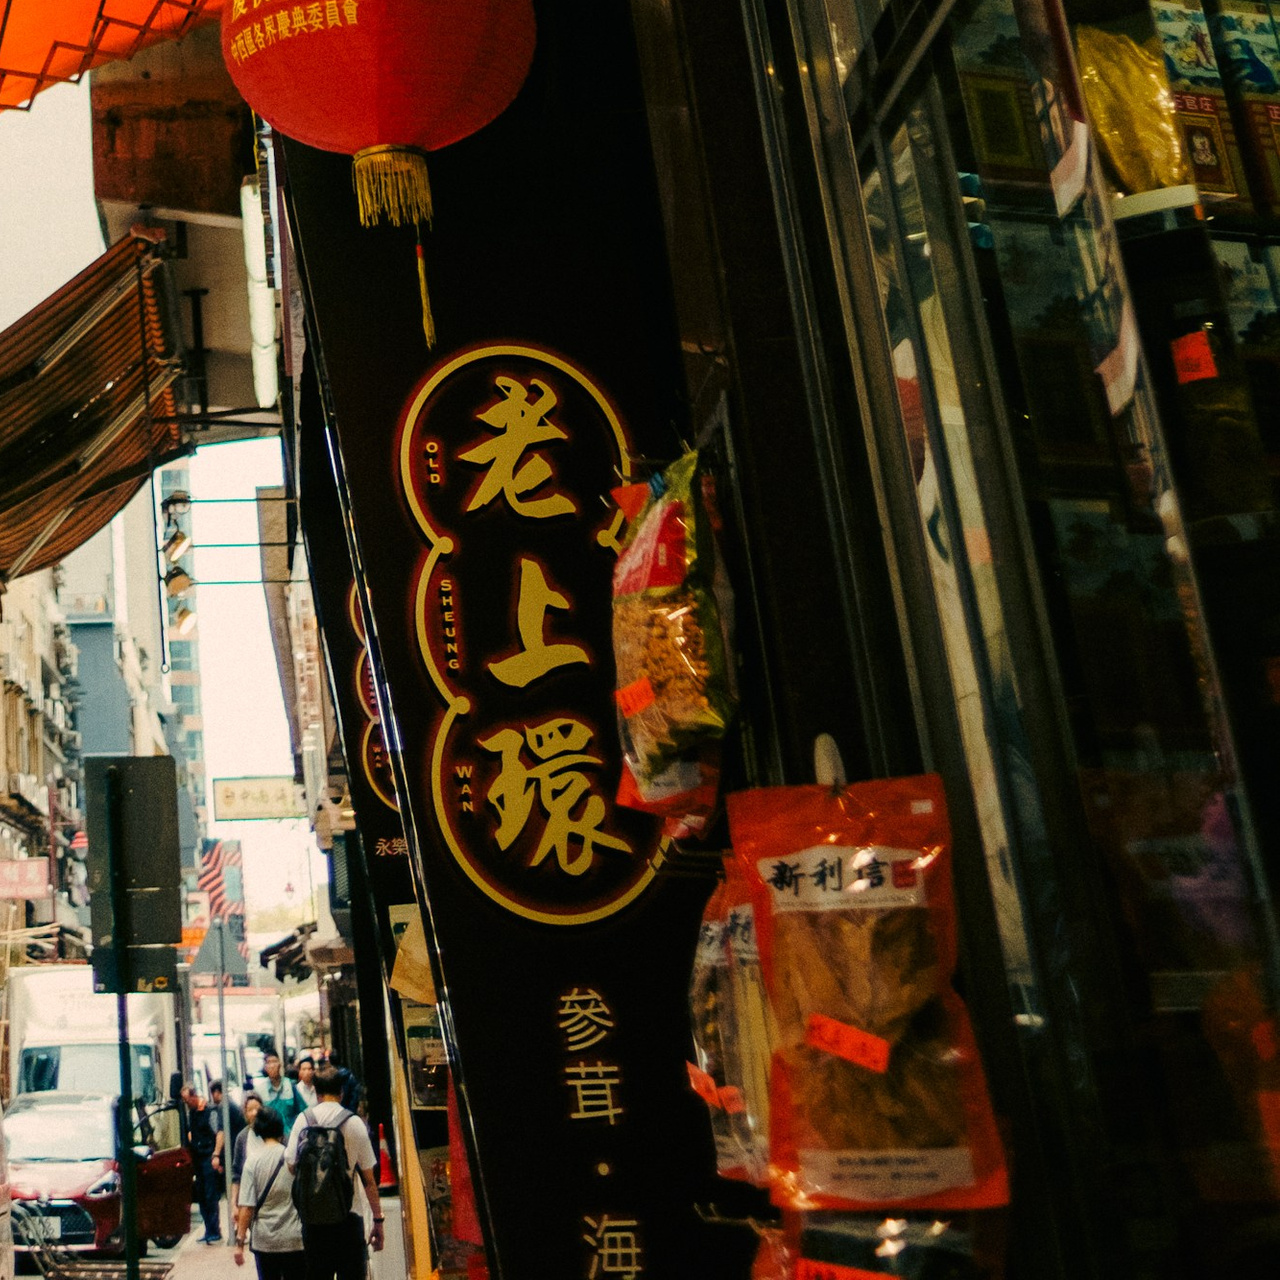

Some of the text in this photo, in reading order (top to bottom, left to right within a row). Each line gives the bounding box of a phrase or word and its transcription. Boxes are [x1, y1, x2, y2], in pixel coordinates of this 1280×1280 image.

[426, 441, 441, 485] OLD
[440, 578, 460, 670] SHEUNG
[455, 765, 474, 813] WAN
[767, 856, 889, 897] 新利信
